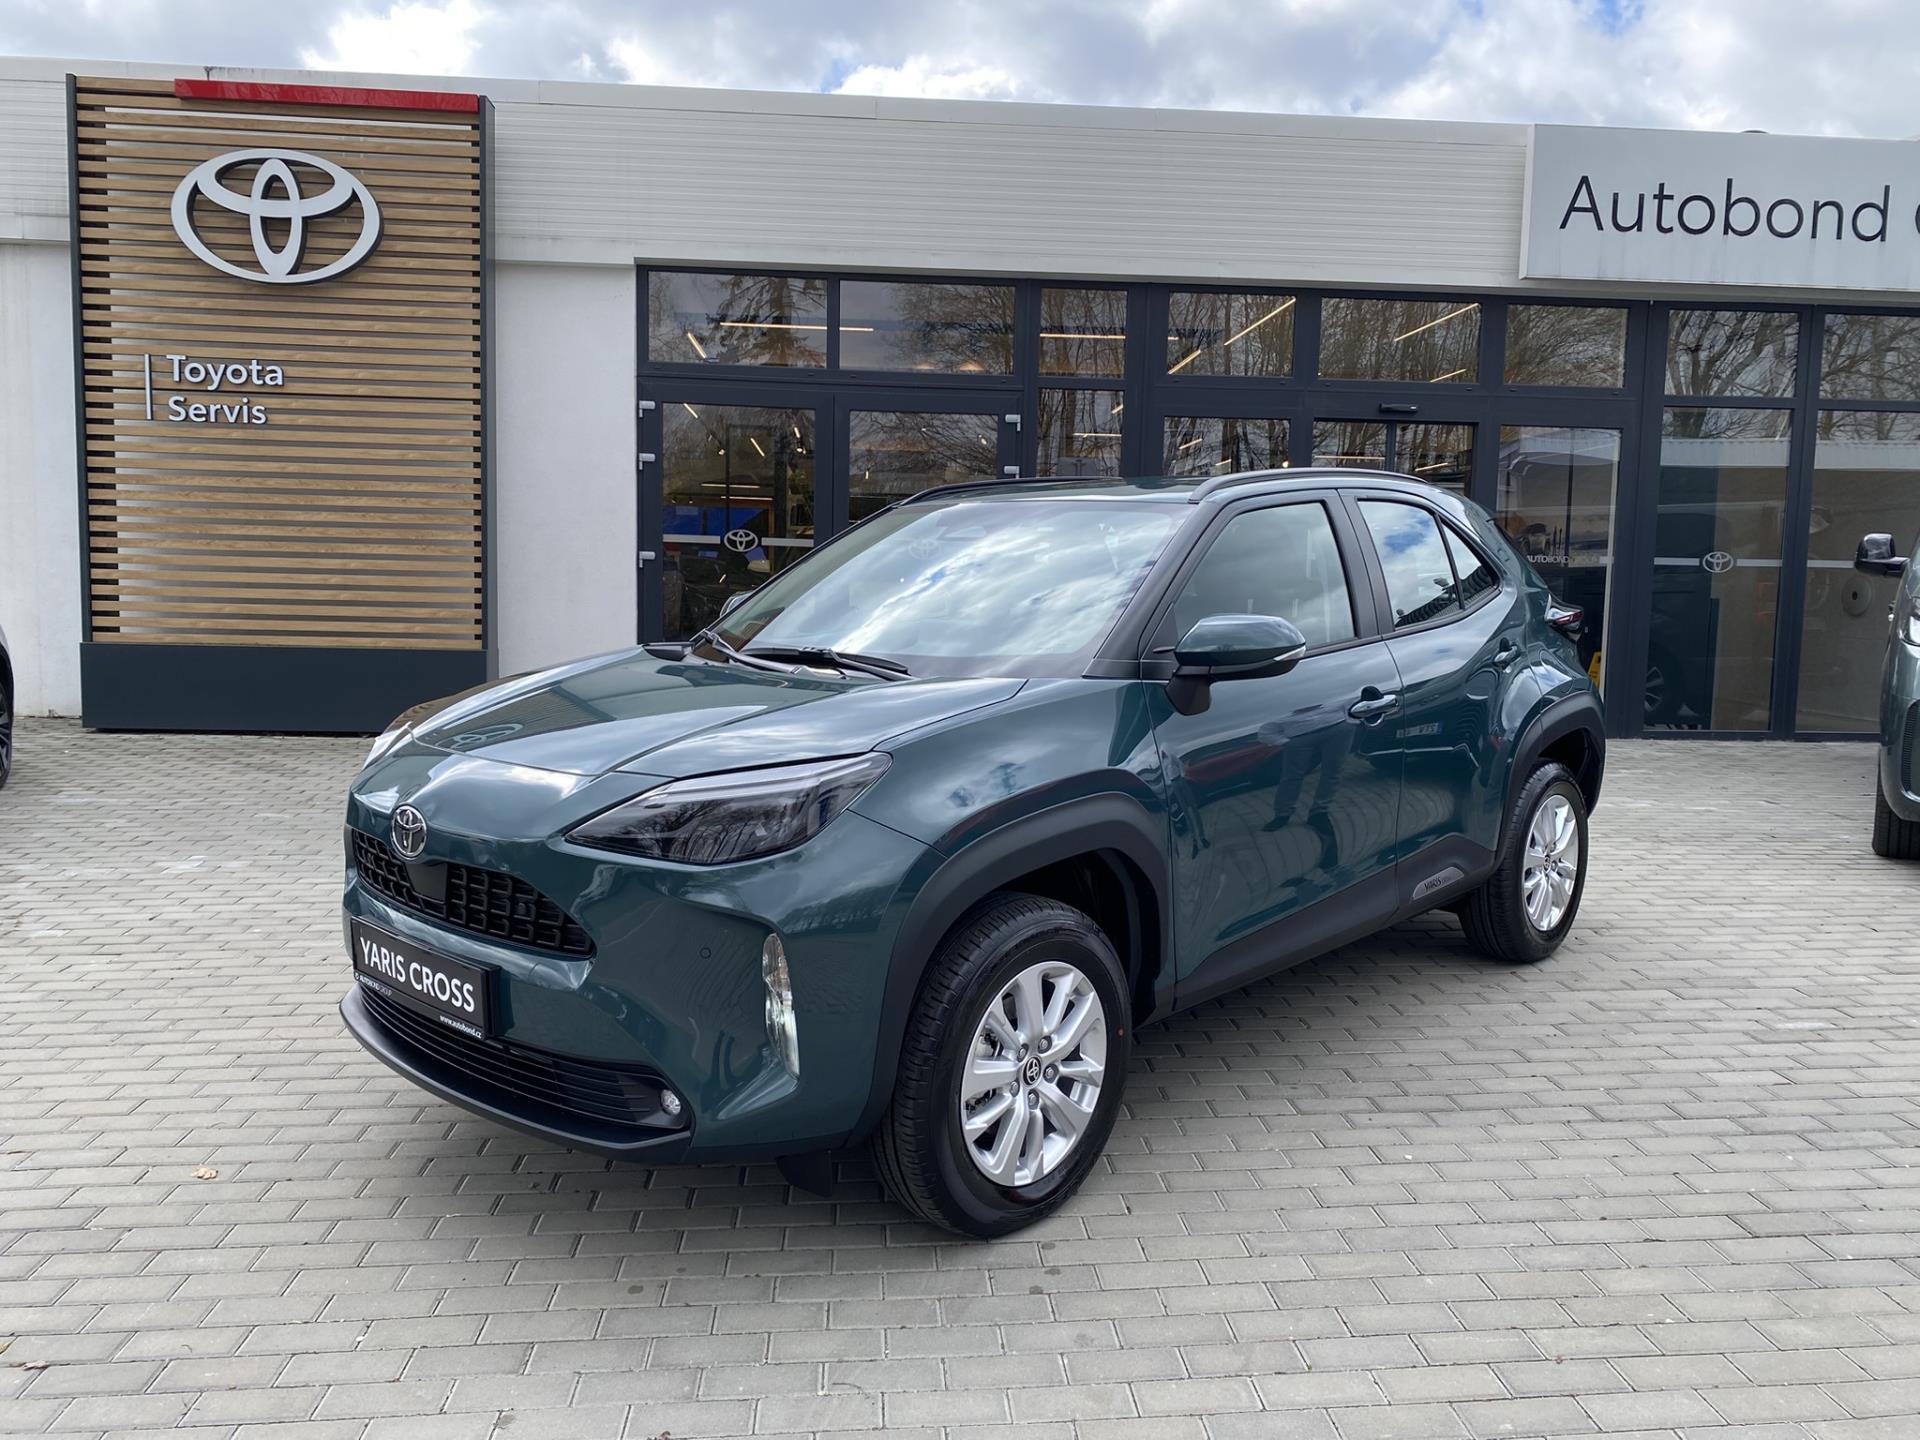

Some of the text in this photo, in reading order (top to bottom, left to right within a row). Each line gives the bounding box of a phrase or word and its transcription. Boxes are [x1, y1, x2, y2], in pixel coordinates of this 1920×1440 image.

[1559, 175, 1891, 242] Autobond
[166, 354, 285, 393] Toyota
[167, 396, 268, 425] Servis
[360, 936, 476, 1013] YARIS CROSS
